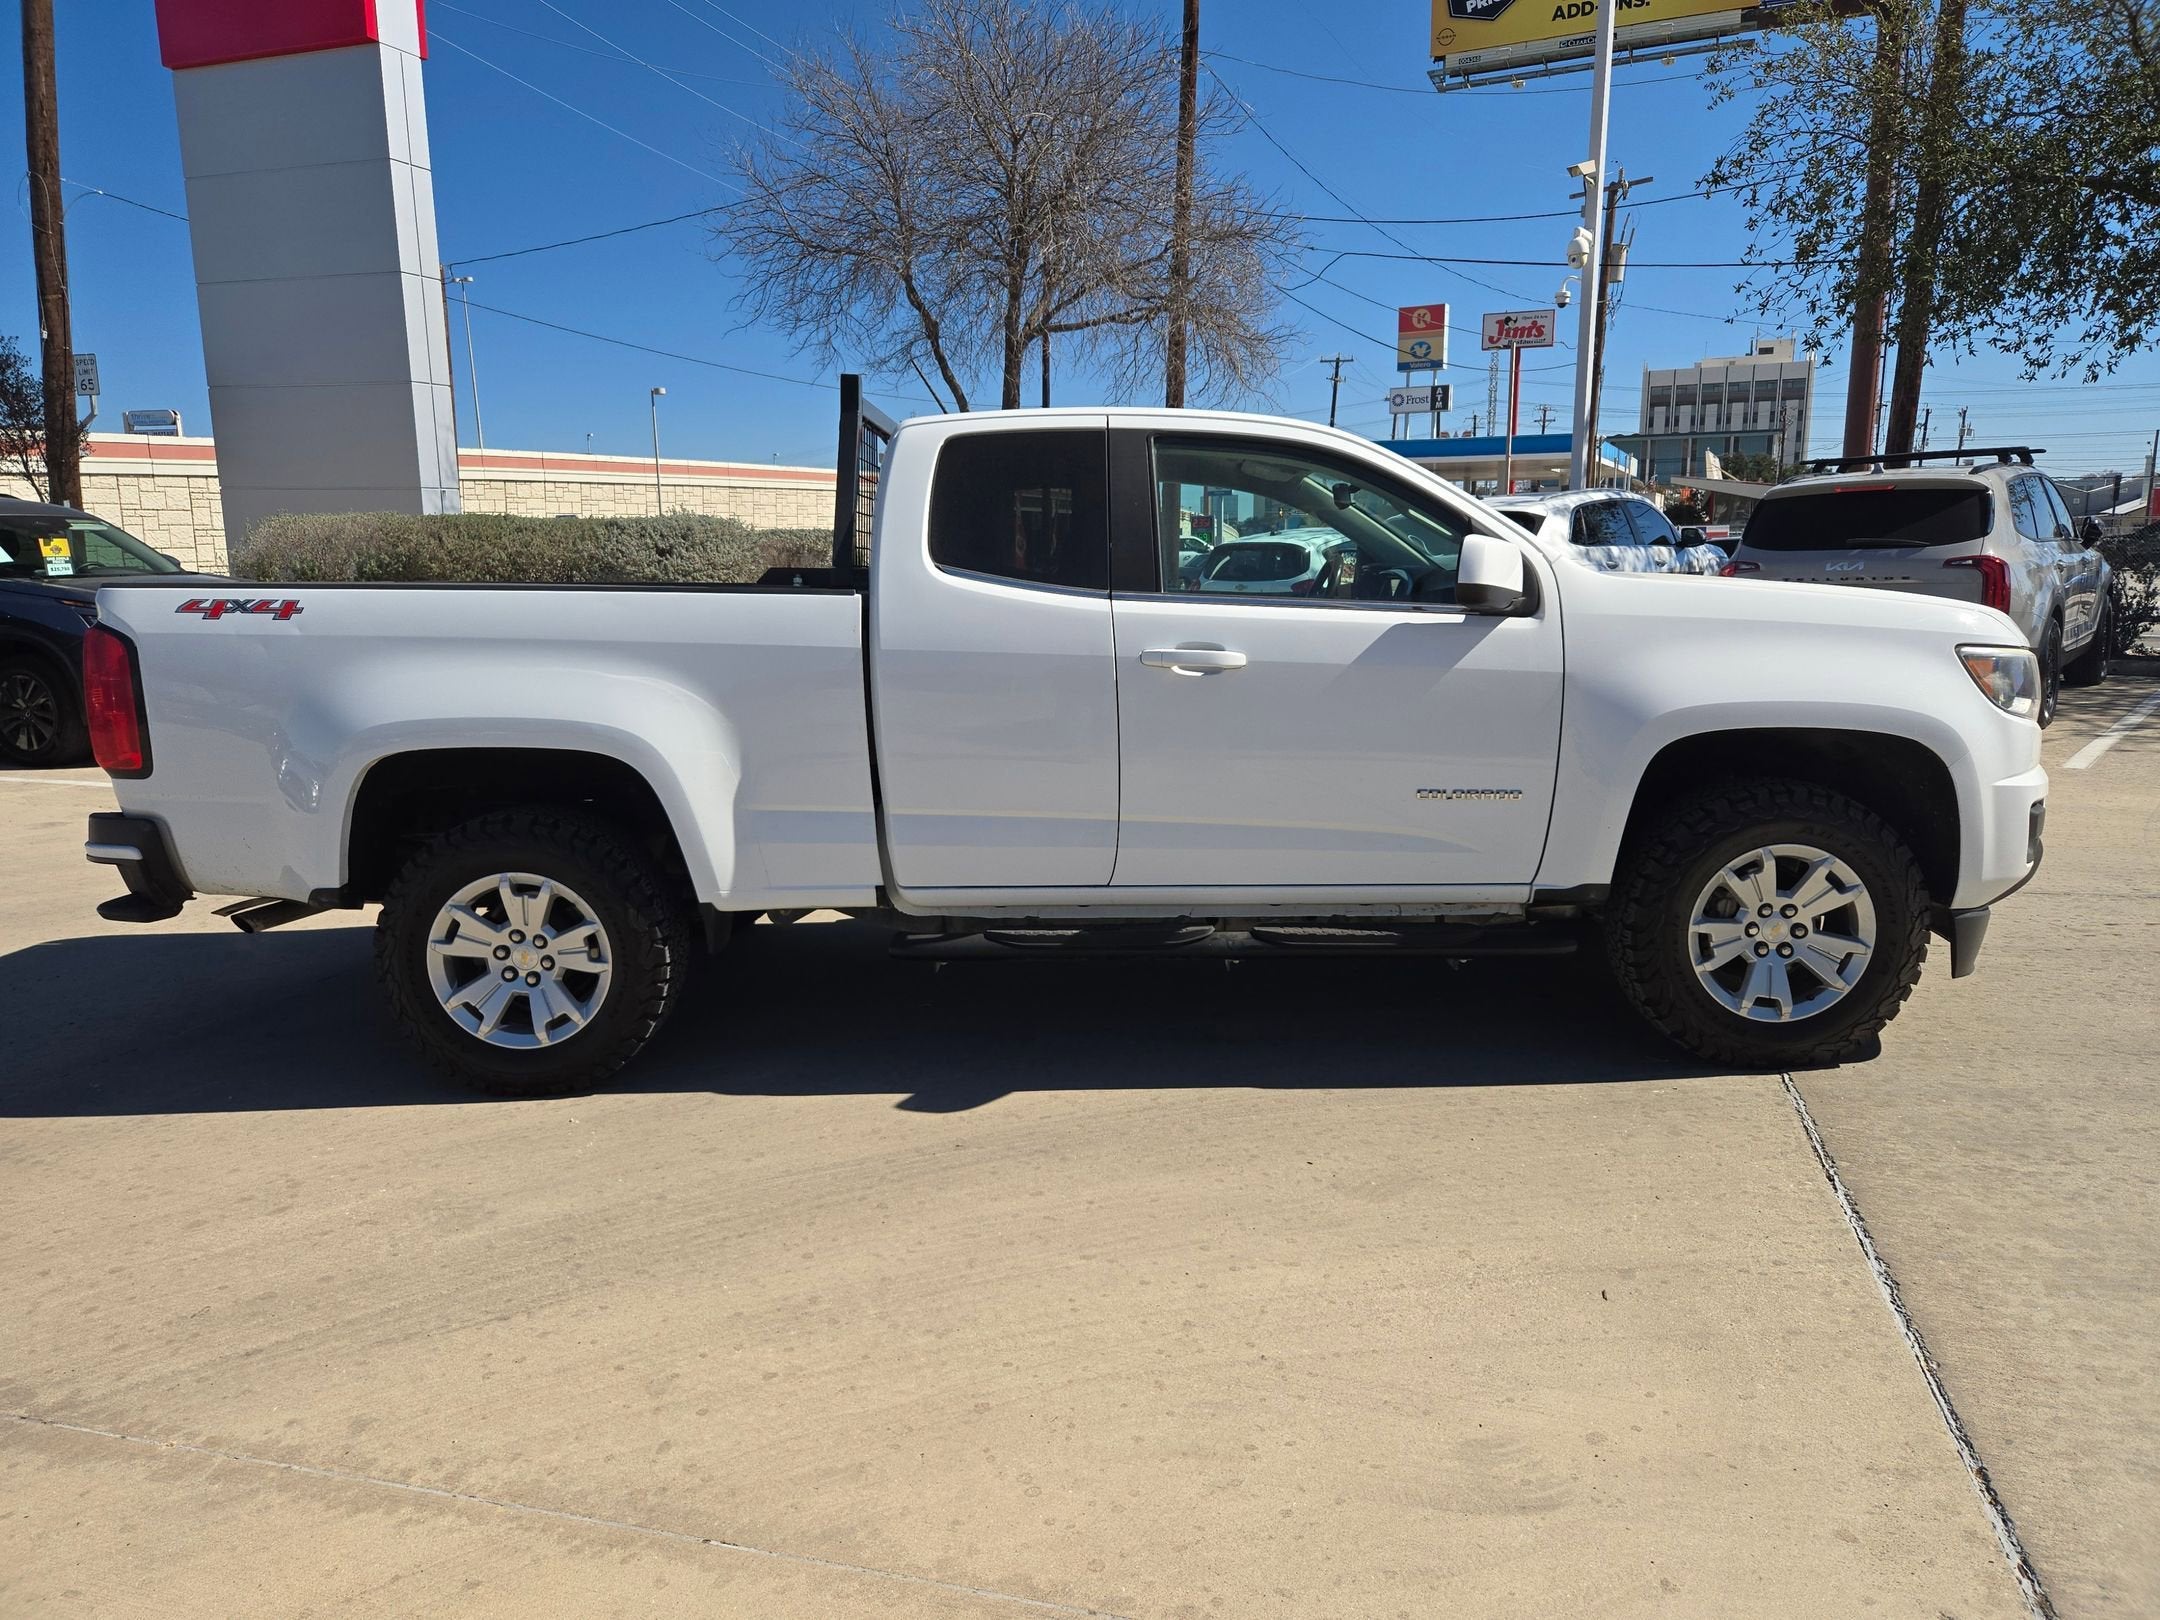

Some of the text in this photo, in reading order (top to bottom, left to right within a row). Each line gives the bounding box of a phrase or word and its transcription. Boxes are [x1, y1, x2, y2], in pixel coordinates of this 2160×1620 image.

[1466, 0, 1502, 13] PR
[1552, 0, 1650, 21] ADD-NS.
[1488, 319, 1546, 345] Jim's
[80, 378, 95, 391] 65
[1406, 395, 1430, 405] Frost
[1435, 387, 1444, 409] ATM
[1417, 789, 1522, 800] COLORADO
